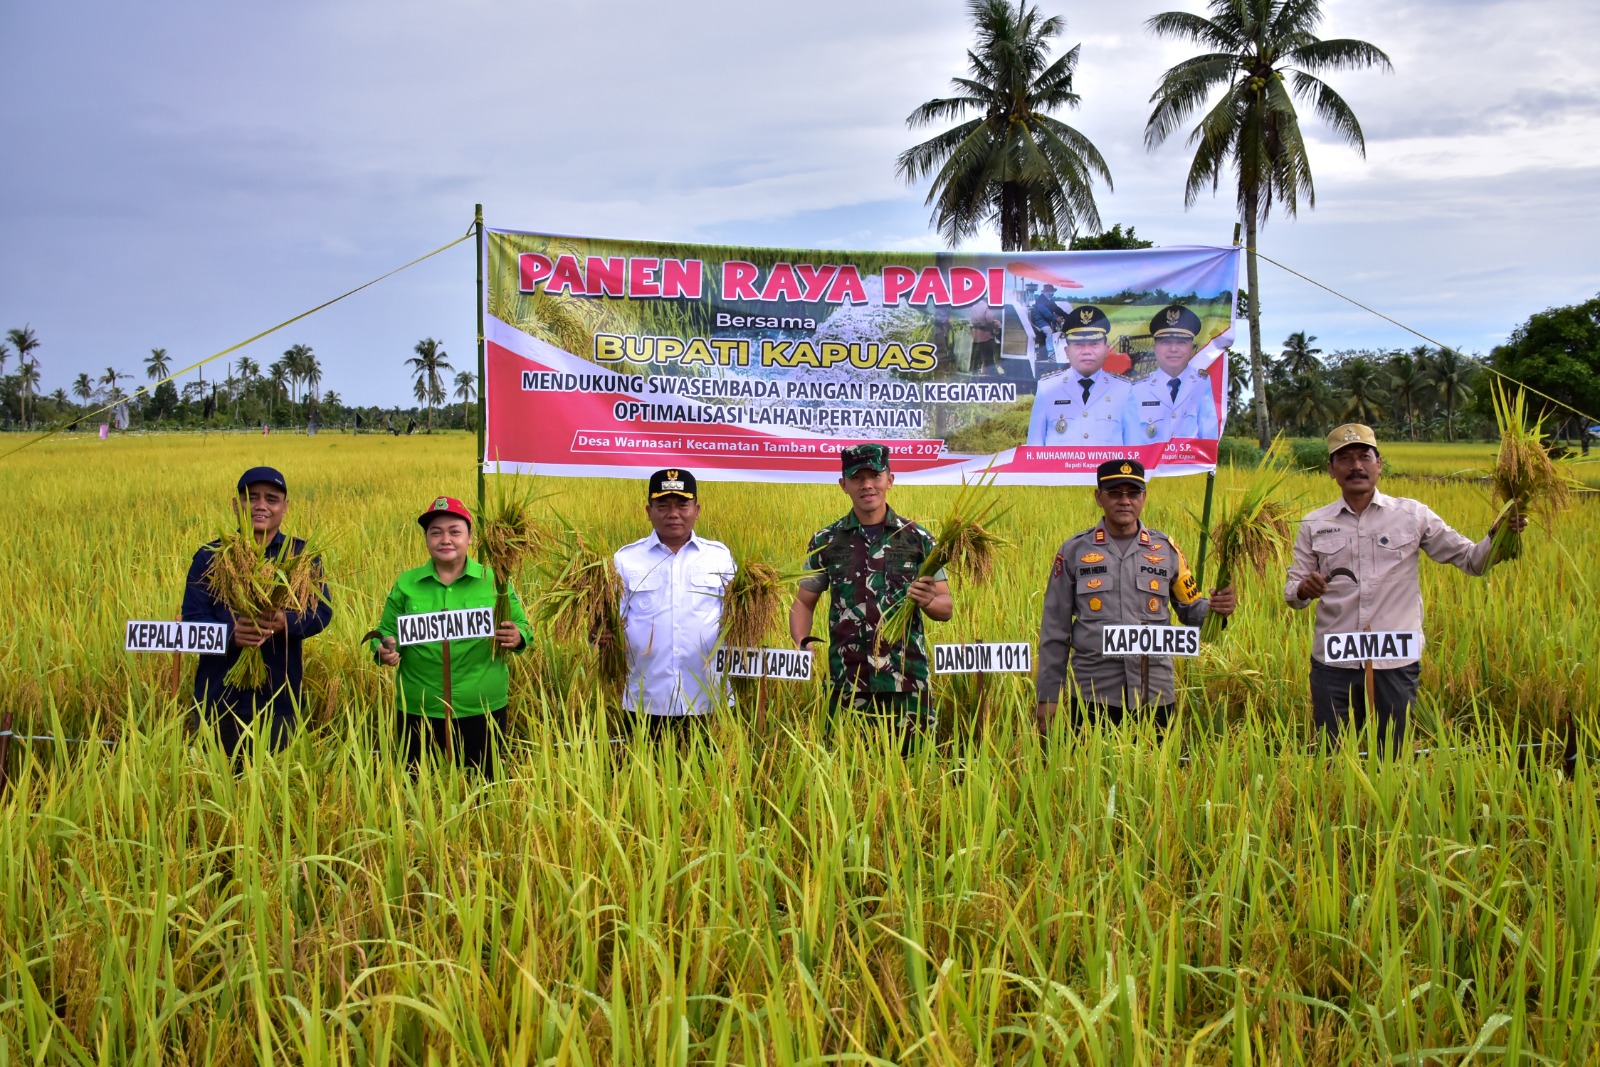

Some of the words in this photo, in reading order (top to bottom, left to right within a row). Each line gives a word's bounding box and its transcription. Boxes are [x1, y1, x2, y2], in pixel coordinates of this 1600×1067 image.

[518, 253, 702, 298] PANEN
[721, 261, 868, 303] RAYA
[882, 265, 1005, 306] PADI
[716, 312, 816, 329] Bersama
[595, 333, 749, 366] BUPATI
[760, 339, 937, 371] KAPUAS
[522, 372, 643, 393] MENDUKUNG
[649, 376, 780, 398] SWASEMBADA
[786, 382, 863, 400] PANGAN
[869, 383, 918, 401] PADA
[923, 384, 1016, 402] KEGIATAN
[615, 402, 743, 423] OPTIMALISASI
[749, 407, 812, 426] LAHAN
[818, 409, 923, 428] PERTANIAN
[578, 435, 610, 446] Desa
[614, 437, 682, 449] Warnasari
[686, 439, 759, 451] Kecamatan
[763, 441, 816, 453] Tamban
[888, 444, 913, 455] aret
[917, 444, 949, 455] 2025
[1026, 451, 1034, 460] H.
[1036, 451, 1086, 460] MUHAMMAD
[1128, 451, 1140, 460] S.P.
[1140, 566, 1167, 577] POLRI
[128, 624, 183, 648] KEPALA
[188, 625, 224, 650] DESA
[400, 613, 463, 642] KADISTAN
[467, 610, 491, 635] KPS
[1104, 628, 1197, 654] KAPOLRES
[1327, 633, 1413, 660] CAMAT
[716, 649, 758, 674] BUPATI
[762, 651, 809, 678] KAPUAS
[936, 646, 992, 670] DANDIM
[996, 645, 1029, 669] 1011
